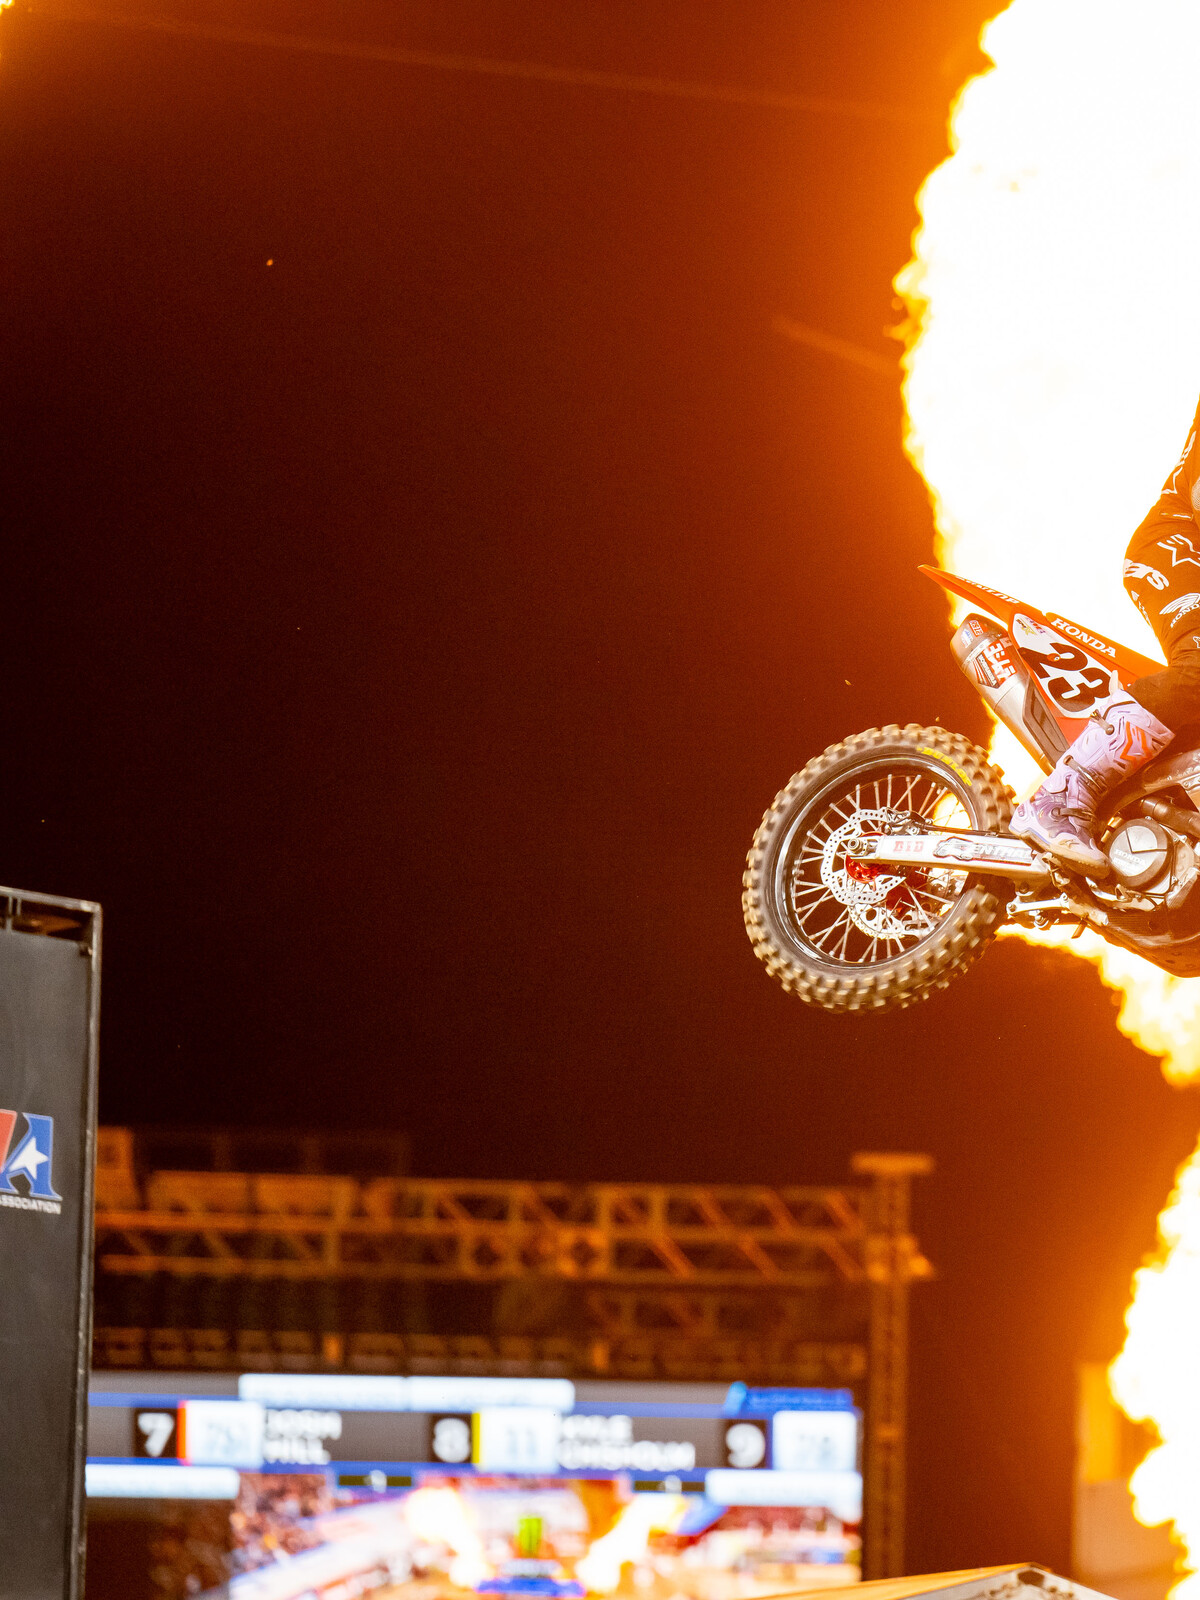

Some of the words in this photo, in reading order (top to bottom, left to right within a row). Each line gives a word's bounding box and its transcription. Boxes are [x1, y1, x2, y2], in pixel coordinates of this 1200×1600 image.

[1050, 618, 1117, 658] HONDA
[1017, 642, 1110, 713] 23
[0, 1194, 61, 1215] SSOCIATION
[138, 1412, 175, 1457] 7
[432, 1417, 471, 1463] 8
[725, 1422, 766, 1468] 9
